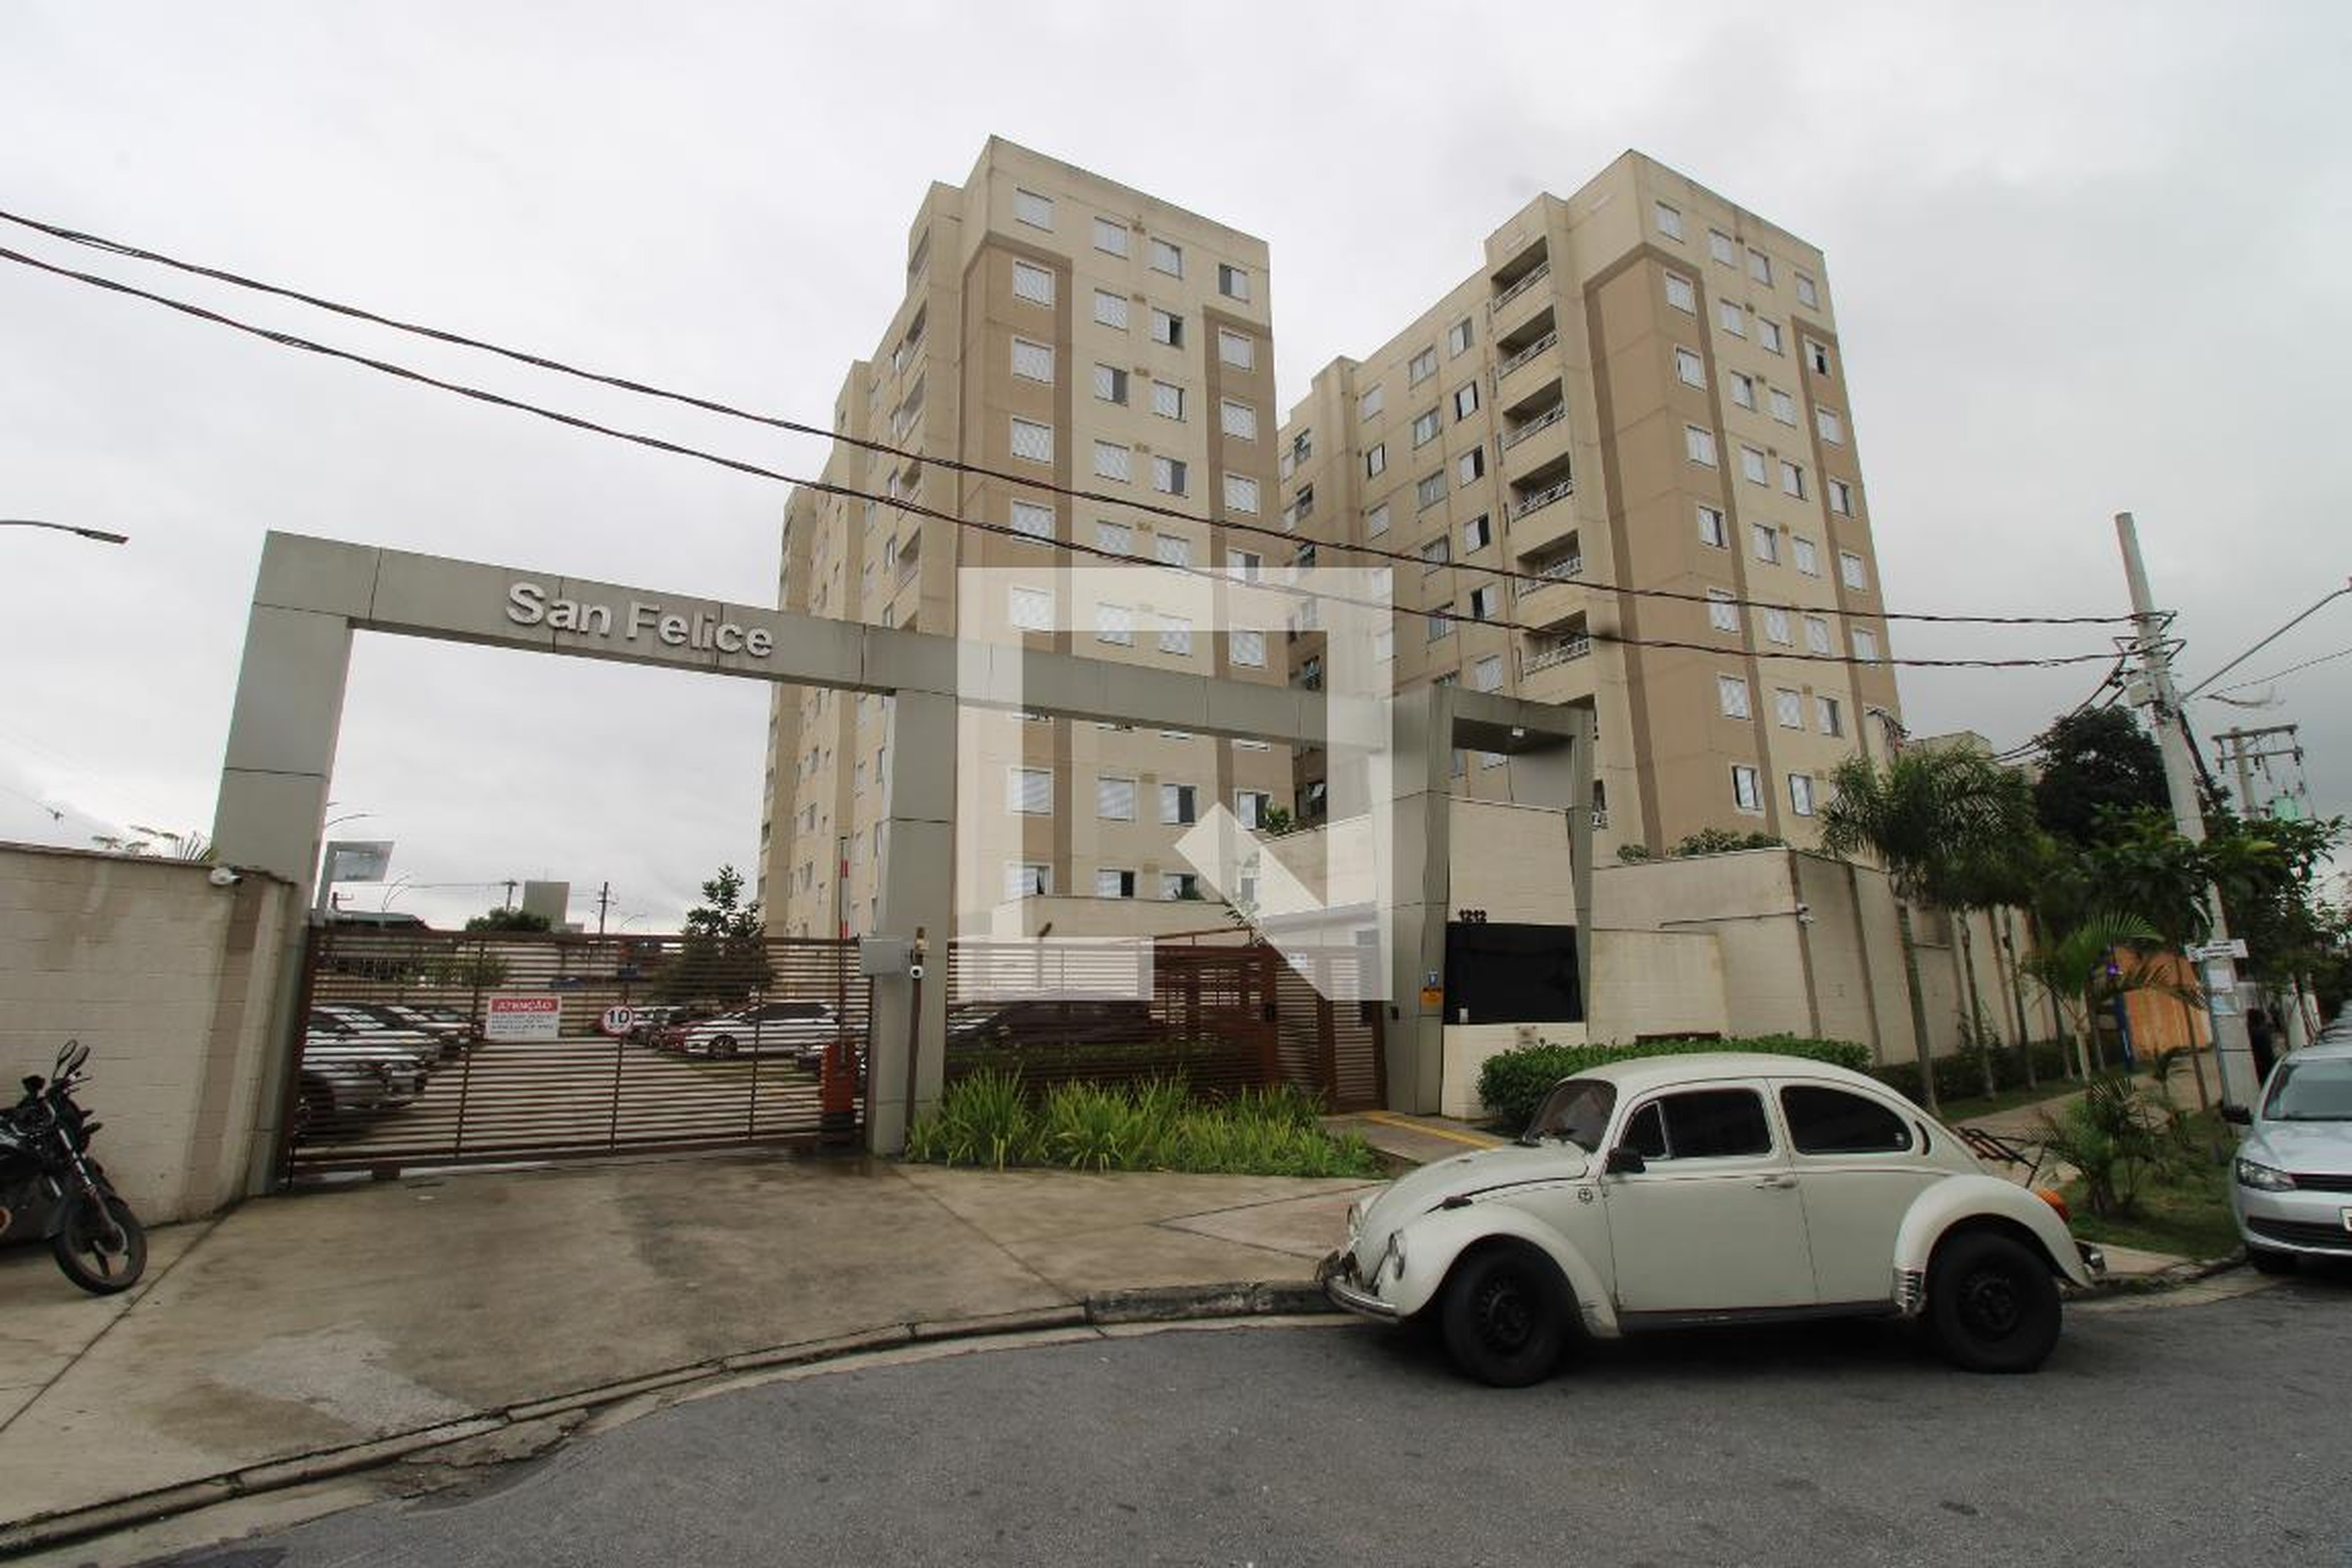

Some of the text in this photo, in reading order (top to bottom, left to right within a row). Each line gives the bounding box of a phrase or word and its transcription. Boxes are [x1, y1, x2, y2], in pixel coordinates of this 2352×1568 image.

[505, 582, 774, 658] San Felice
[1458, 909, 1487, 923] 1212
[497, 1000, 552, 1011] ATENÇÃO
[608, 1009, 630, 1023] 10
